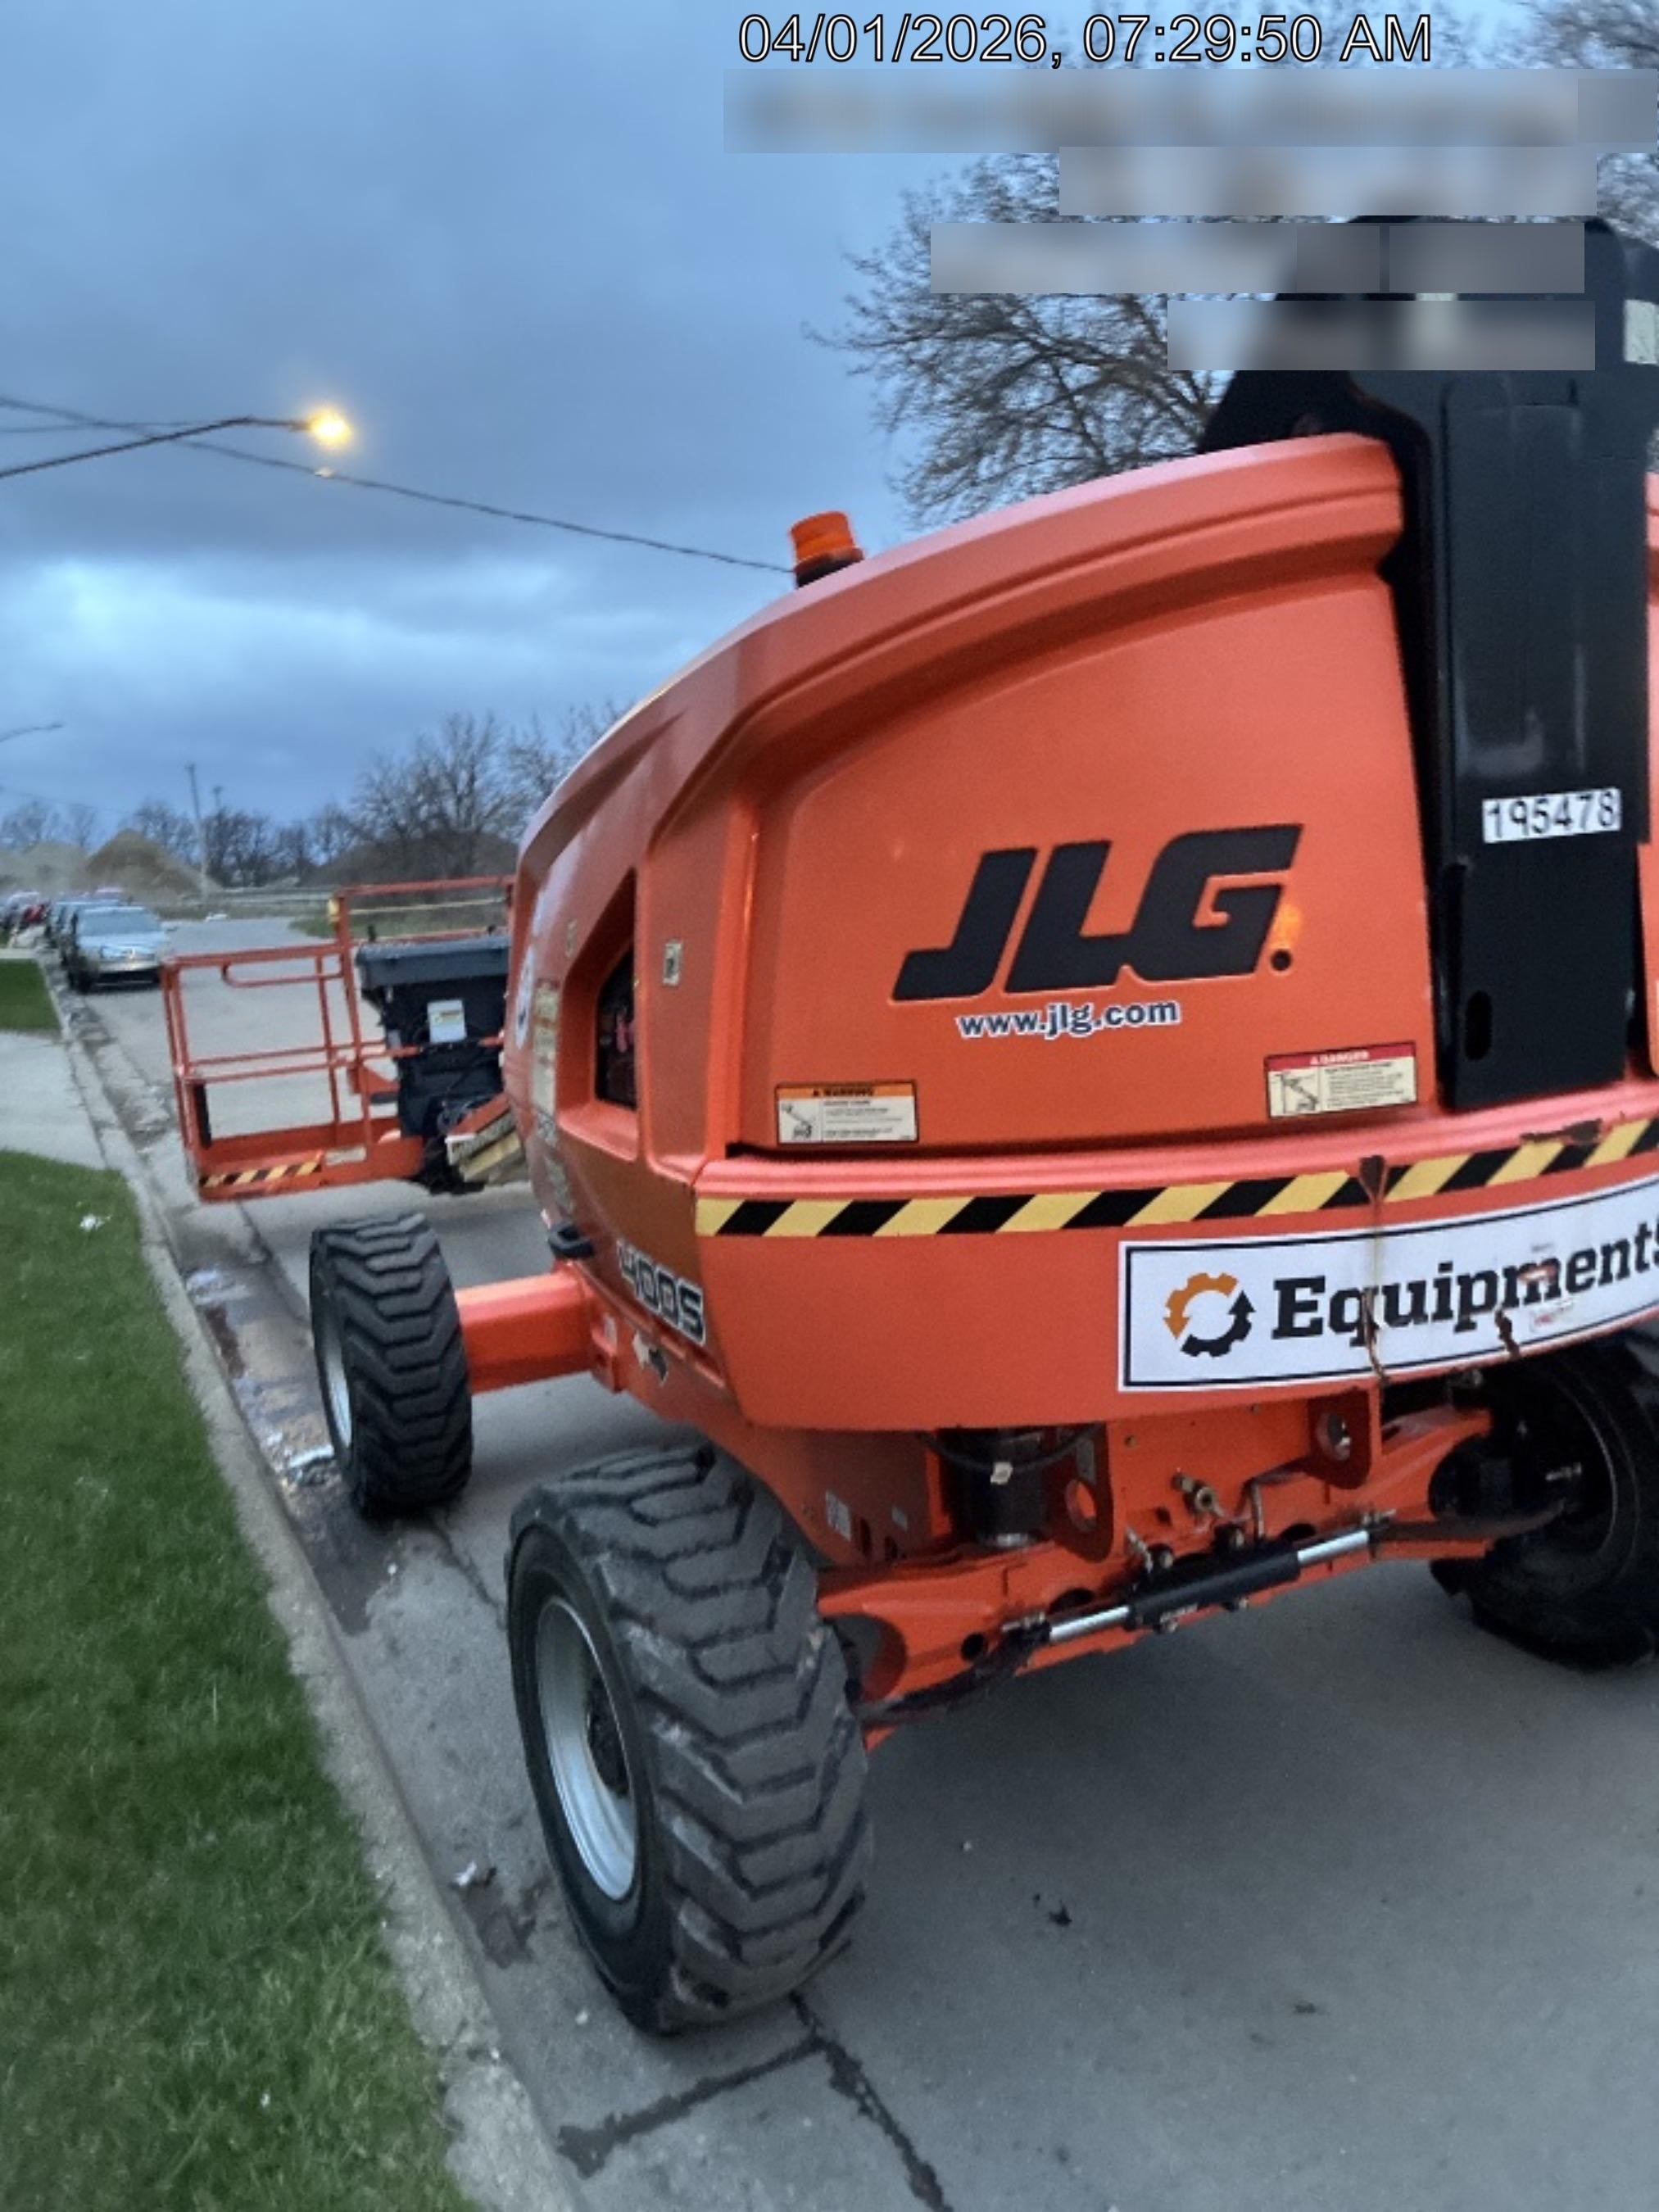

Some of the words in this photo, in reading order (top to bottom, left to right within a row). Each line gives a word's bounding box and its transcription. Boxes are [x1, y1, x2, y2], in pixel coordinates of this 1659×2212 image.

[1487, 791, 1617, 838] 195478
[959, 1001, 1180, 1037] www.jlg.com
[617, 1240, 705, 1346] 400S
[1272, 1213, 1659, 1347] Equipment
